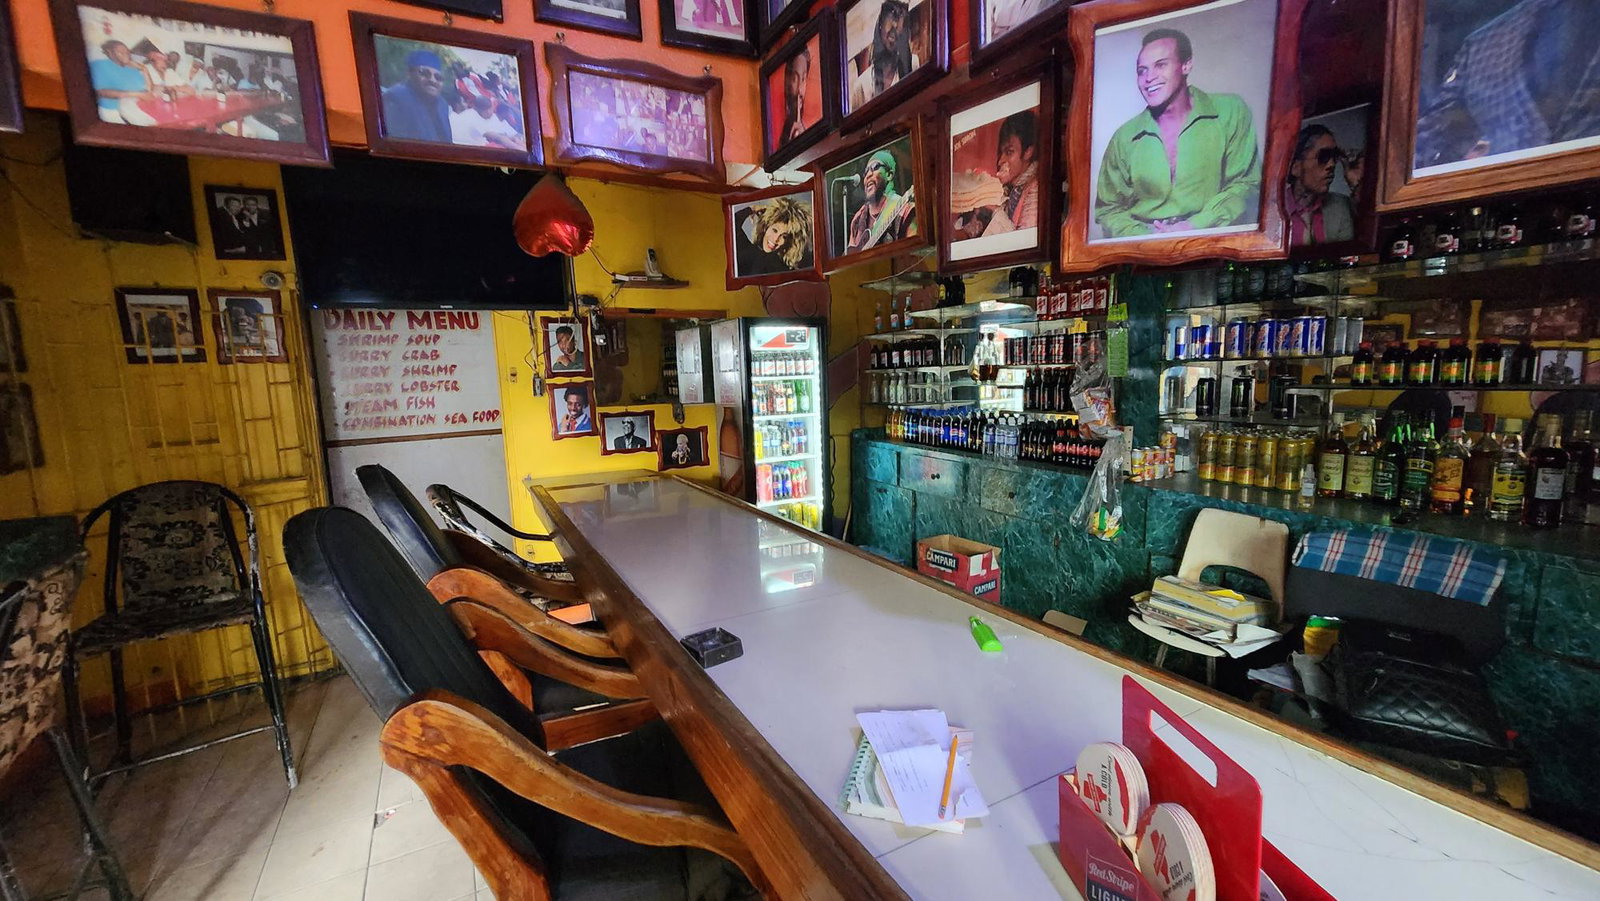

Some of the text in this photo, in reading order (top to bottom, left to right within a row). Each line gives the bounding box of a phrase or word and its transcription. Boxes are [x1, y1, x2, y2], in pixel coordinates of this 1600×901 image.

[323, 308, 479, 330] DAILY MENU
[337, 334, 441, 346] SHRIMP SOUP
[402, 350, 440, 361] CRAB
[401, 365, 457, 377] SHRIMP
[401, 380, 460, 393] LOBSTER
[344, 396, 436, 415] STEAM FISH
[342, 409, 500, 431] COMBINATION SEA FOOD
[926, 551, 956, 568] CAMPARI
[974, 581, 996, 595] CAMPARI
[1089, 863, 1135, 891] Red Stripe
[1091, 885, 1127, 901] LIGH
